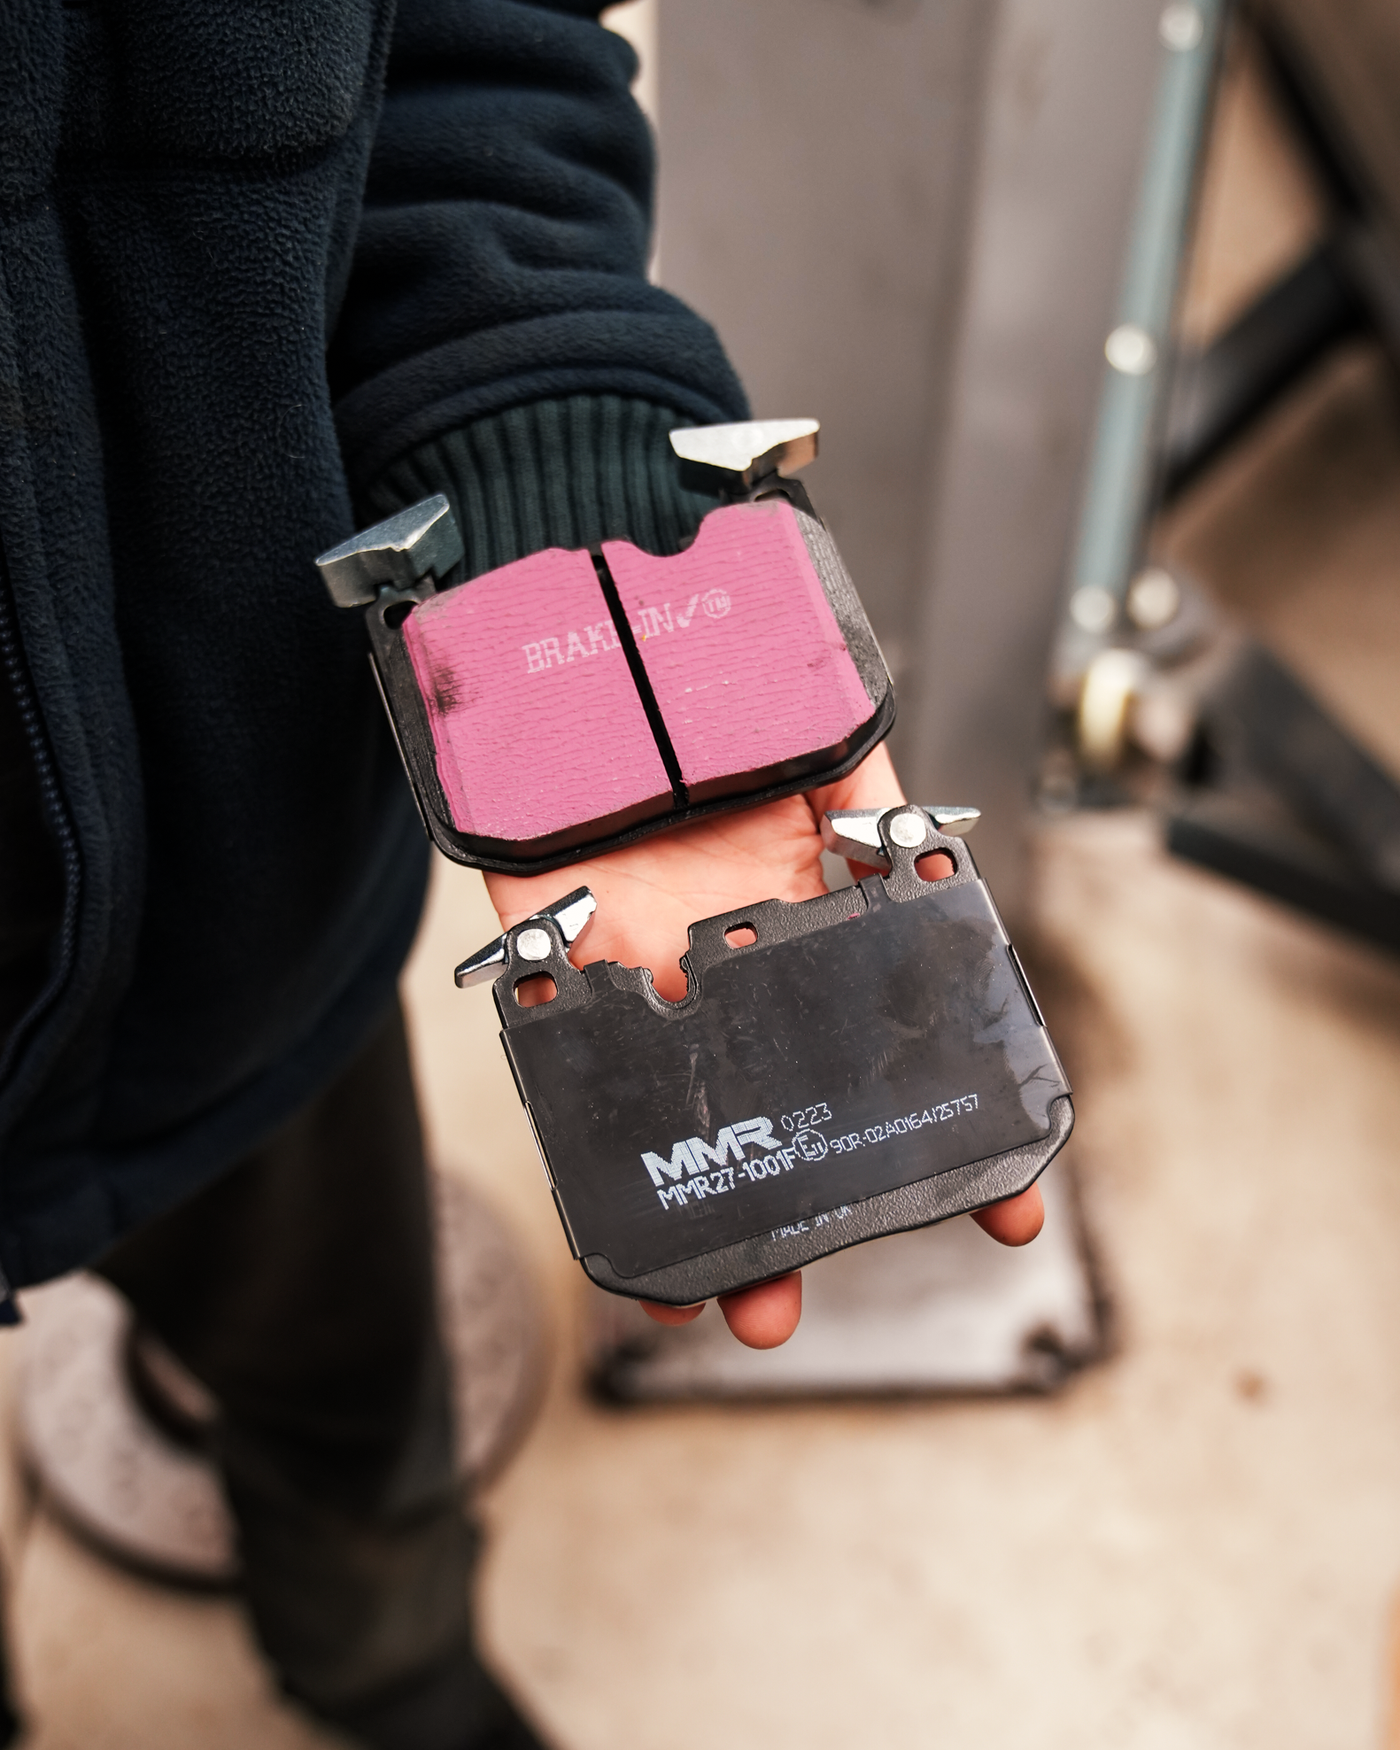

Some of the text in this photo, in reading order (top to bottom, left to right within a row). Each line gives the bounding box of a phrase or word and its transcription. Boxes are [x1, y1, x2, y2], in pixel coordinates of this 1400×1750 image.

[703, 592, 729, 615] TM
[781, 1102, 832, 1132] 0223
[640, 1116, 783, 1187] MMR
[656, 1146, 796, 1211] MMR27-1001F
